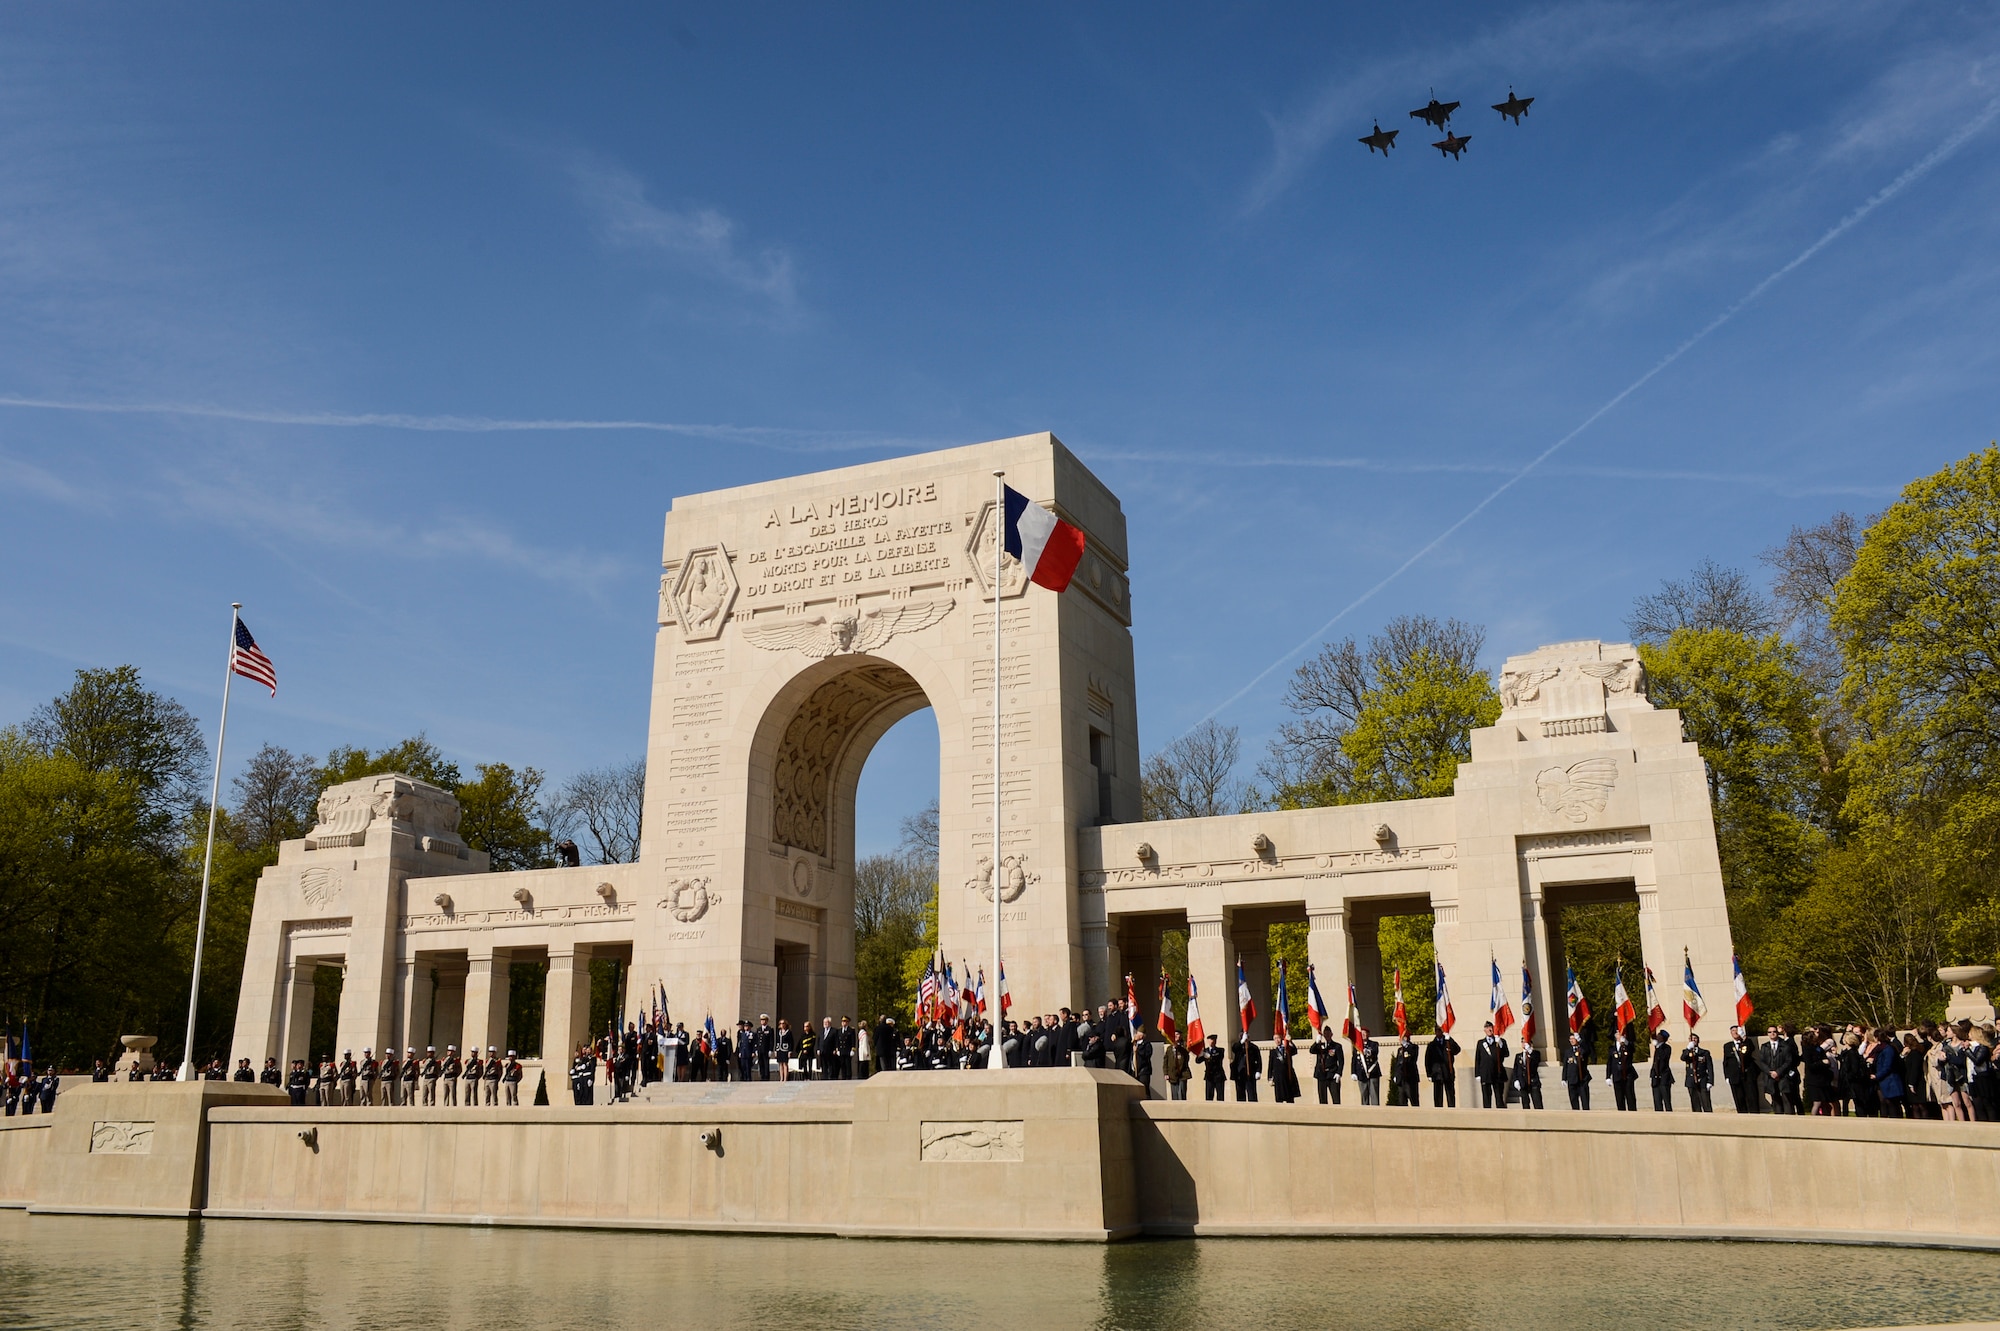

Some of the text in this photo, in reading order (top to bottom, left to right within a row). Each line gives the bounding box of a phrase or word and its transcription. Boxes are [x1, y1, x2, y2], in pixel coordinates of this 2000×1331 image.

[764, 482, 937, 528] A LA MEMOIRE
[809, 515, 888, 538] DES HEROS
[748, 521, 953, 564] DE L'ESCADRILLE LA FAYETTE
[763, 541, 937, 579] MORTS POUR LA DEFENSE
[747, 556, 951, 597] DU DROIT ET DE LA LIBERTE
[1531, 830, 1635, 850] ARGONNE
[1242, 858, 1286, 874] OISE
[1349, 846, 1424, 867] ALSACE
[1107, 866, 1184, 883] VOSGES
[424, 913, 468, 926] SOMME
[504, 909, 544, 922] AISNE
[583, 903, 631, 917] MARNE
[778, 901, 817, 922] FAYETTE
[975, 910, 1027, 924] MCXVIII
